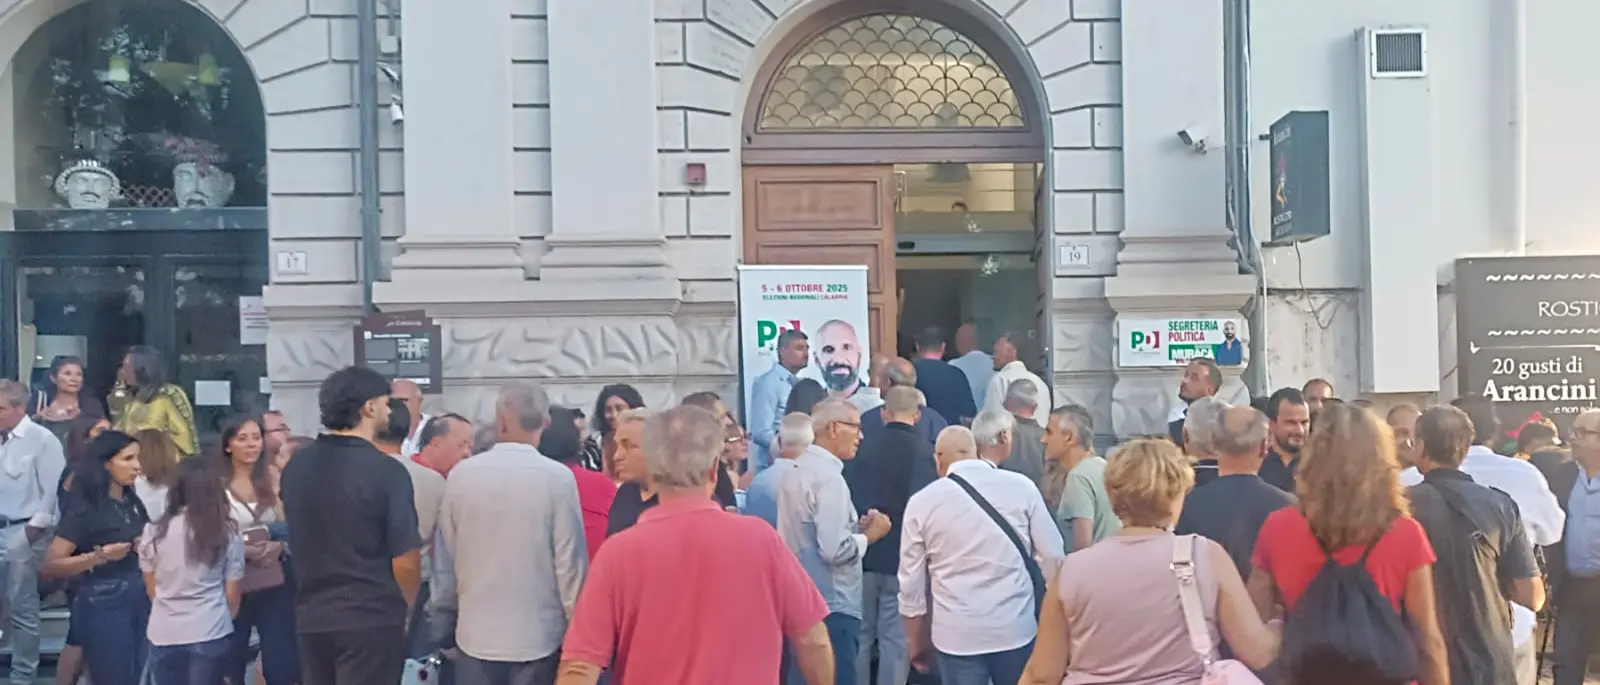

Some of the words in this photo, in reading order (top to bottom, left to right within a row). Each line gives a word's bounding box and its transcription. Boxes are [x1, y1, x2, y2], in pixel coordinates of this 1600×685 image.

[287, 256, 300, 269] 17
[1069, 251, 1081, 262] 19
[761, 284, 768, 292] 5
[776, 284, 782, 292] 6
[785, 284, 823, 292] OTTOBRE
[826, 284, 848, 292] 2025
[1538, 301, 1600, 317] ROSTI
[1168, 320, 1218, 330] SEGRETERIA
[1131, 331, 1159, 348] PD
[1168, 332, 1205, 341] POLITICA
[1492, 358, 1514, 374] 20
[1519, 357, 1561, 379] gusti
[1566, 356, 1583, 373] di
[1483, 378, 1597, 401] Arancini
